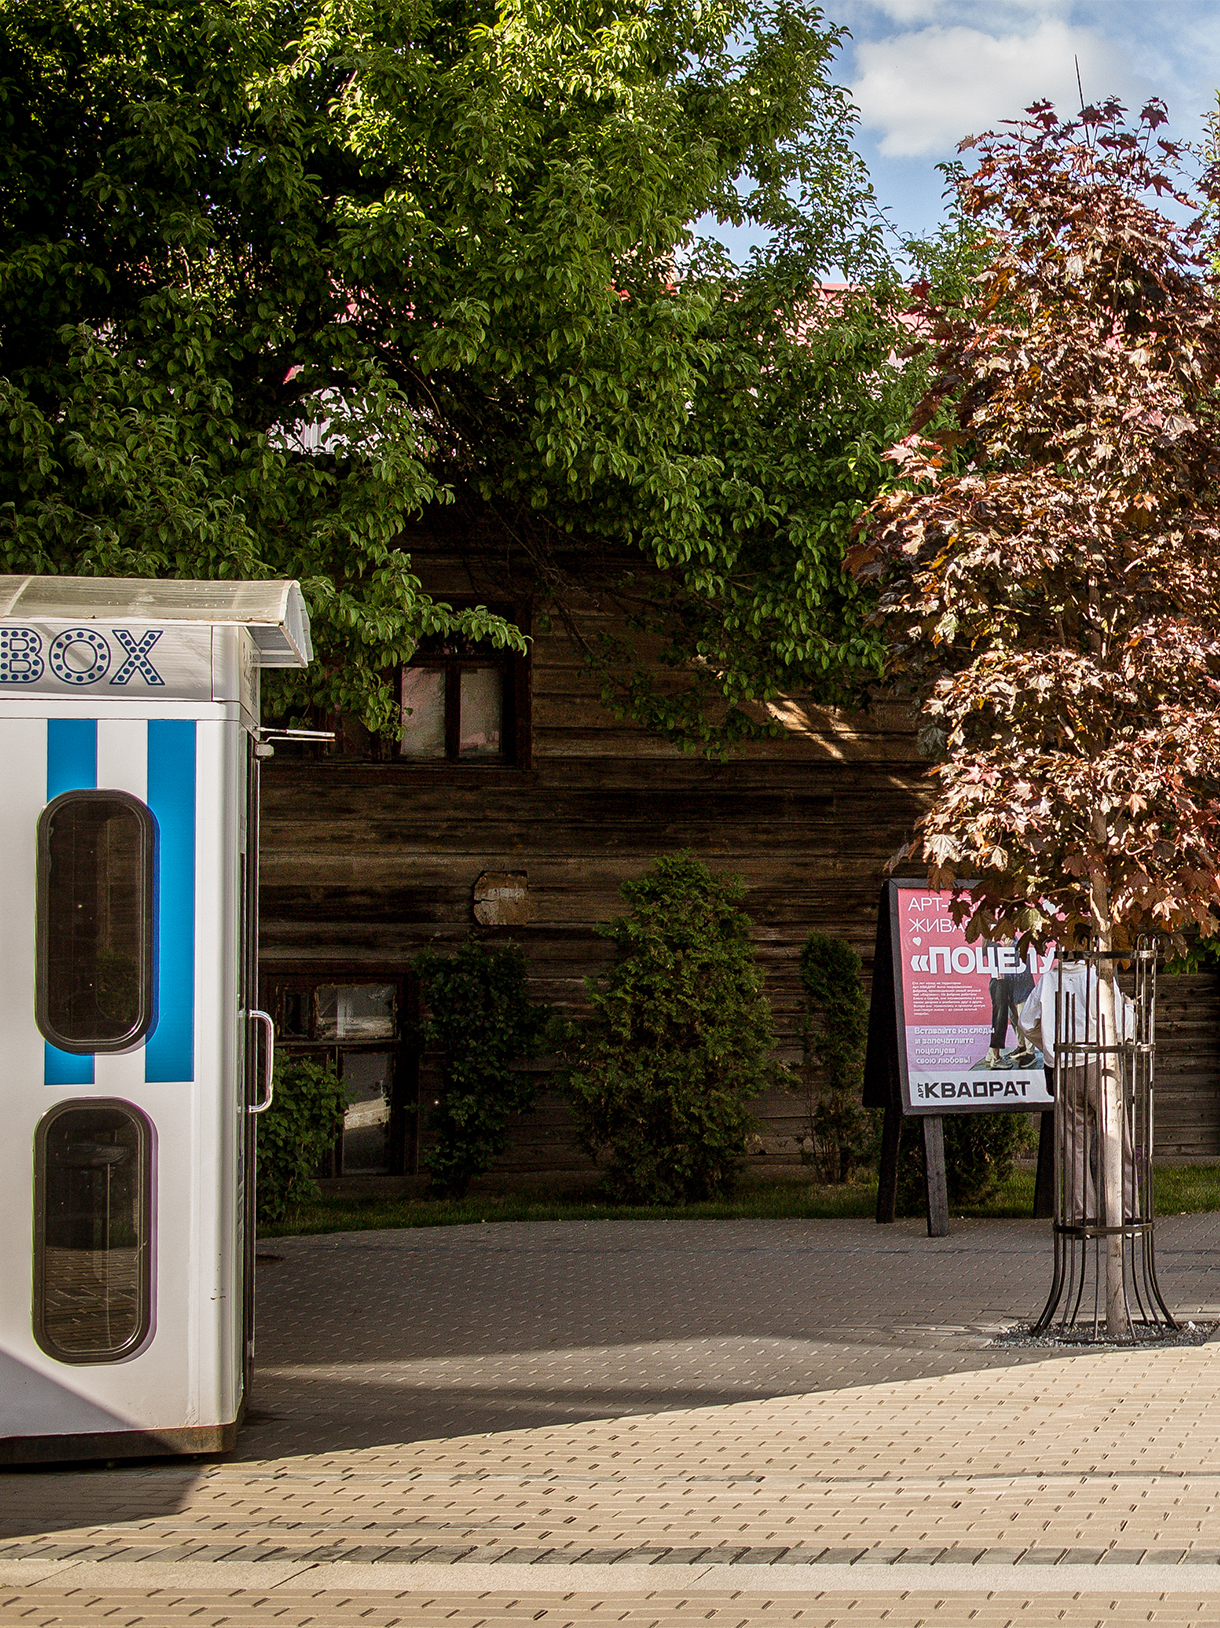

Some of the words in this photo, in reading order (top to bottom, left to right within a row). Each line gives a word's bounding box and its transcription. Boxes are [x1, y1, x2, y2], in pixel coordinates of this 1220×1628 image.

[0, 627, 165, 686] BOX
[914, 1026, 957, 1035] Вставайте
[969, 1027, 995, 1035] следы
[922, 1037, 975, 1045] запечатлите
[915, 1047, 956, 1056] поцелуем
[937, 1056, 971, 1064] любовь!
